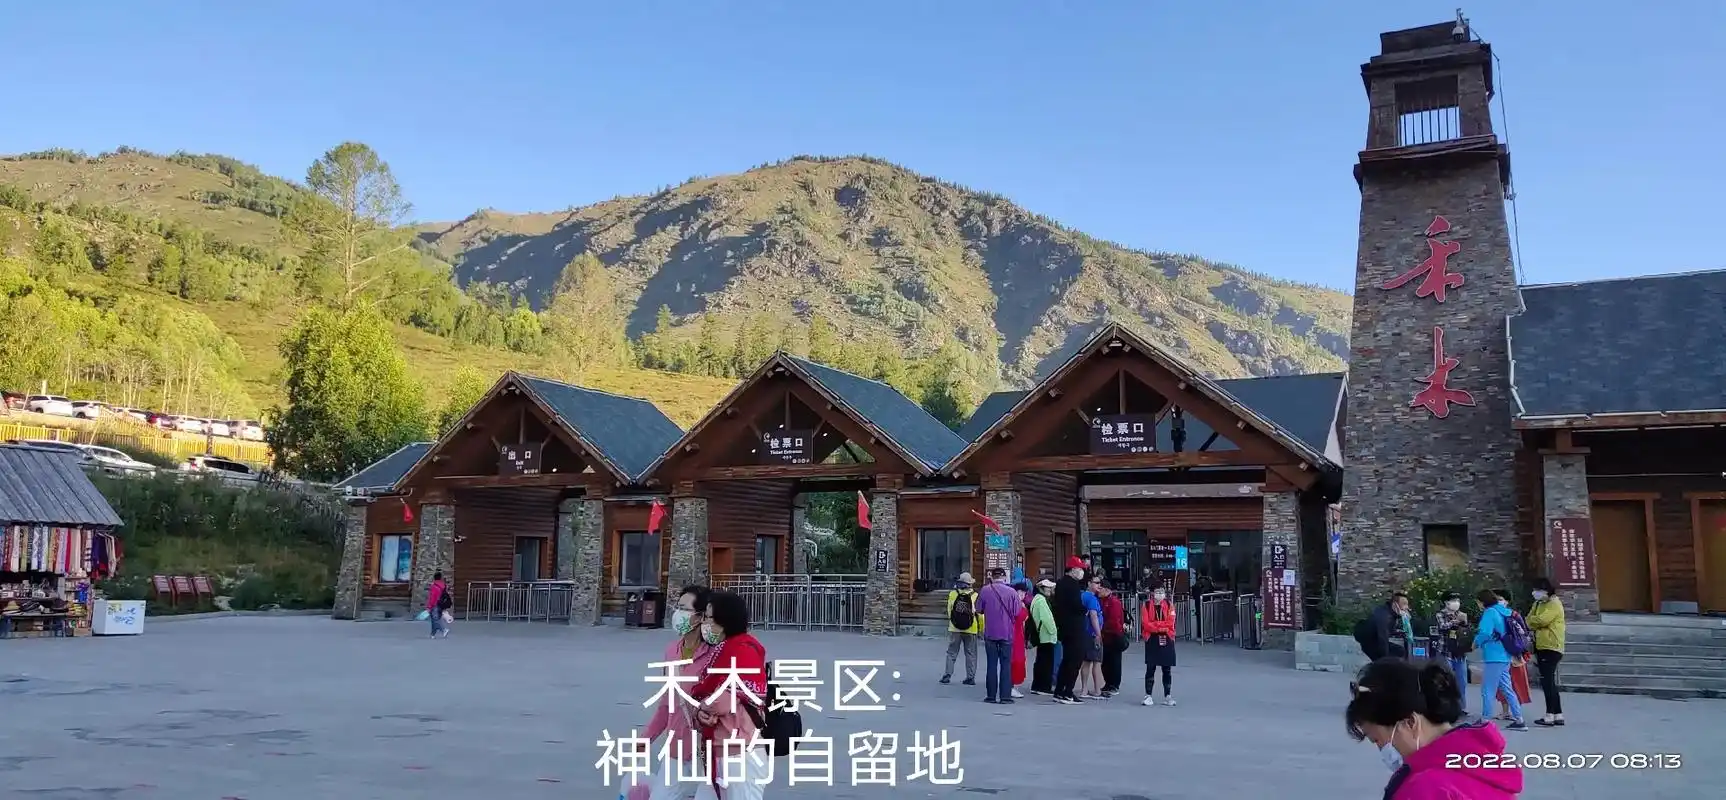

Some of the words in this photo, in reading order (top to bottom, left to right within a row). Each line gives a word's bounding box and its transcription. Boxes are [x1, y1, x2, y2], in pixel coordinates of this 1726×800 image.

[1379, 215, 1476, 418] 禾木
[1101, 422, 1144, 435] 检票口
[770, 437, 803, 449] 检票口
[508, 450, 532, 460] 出口
